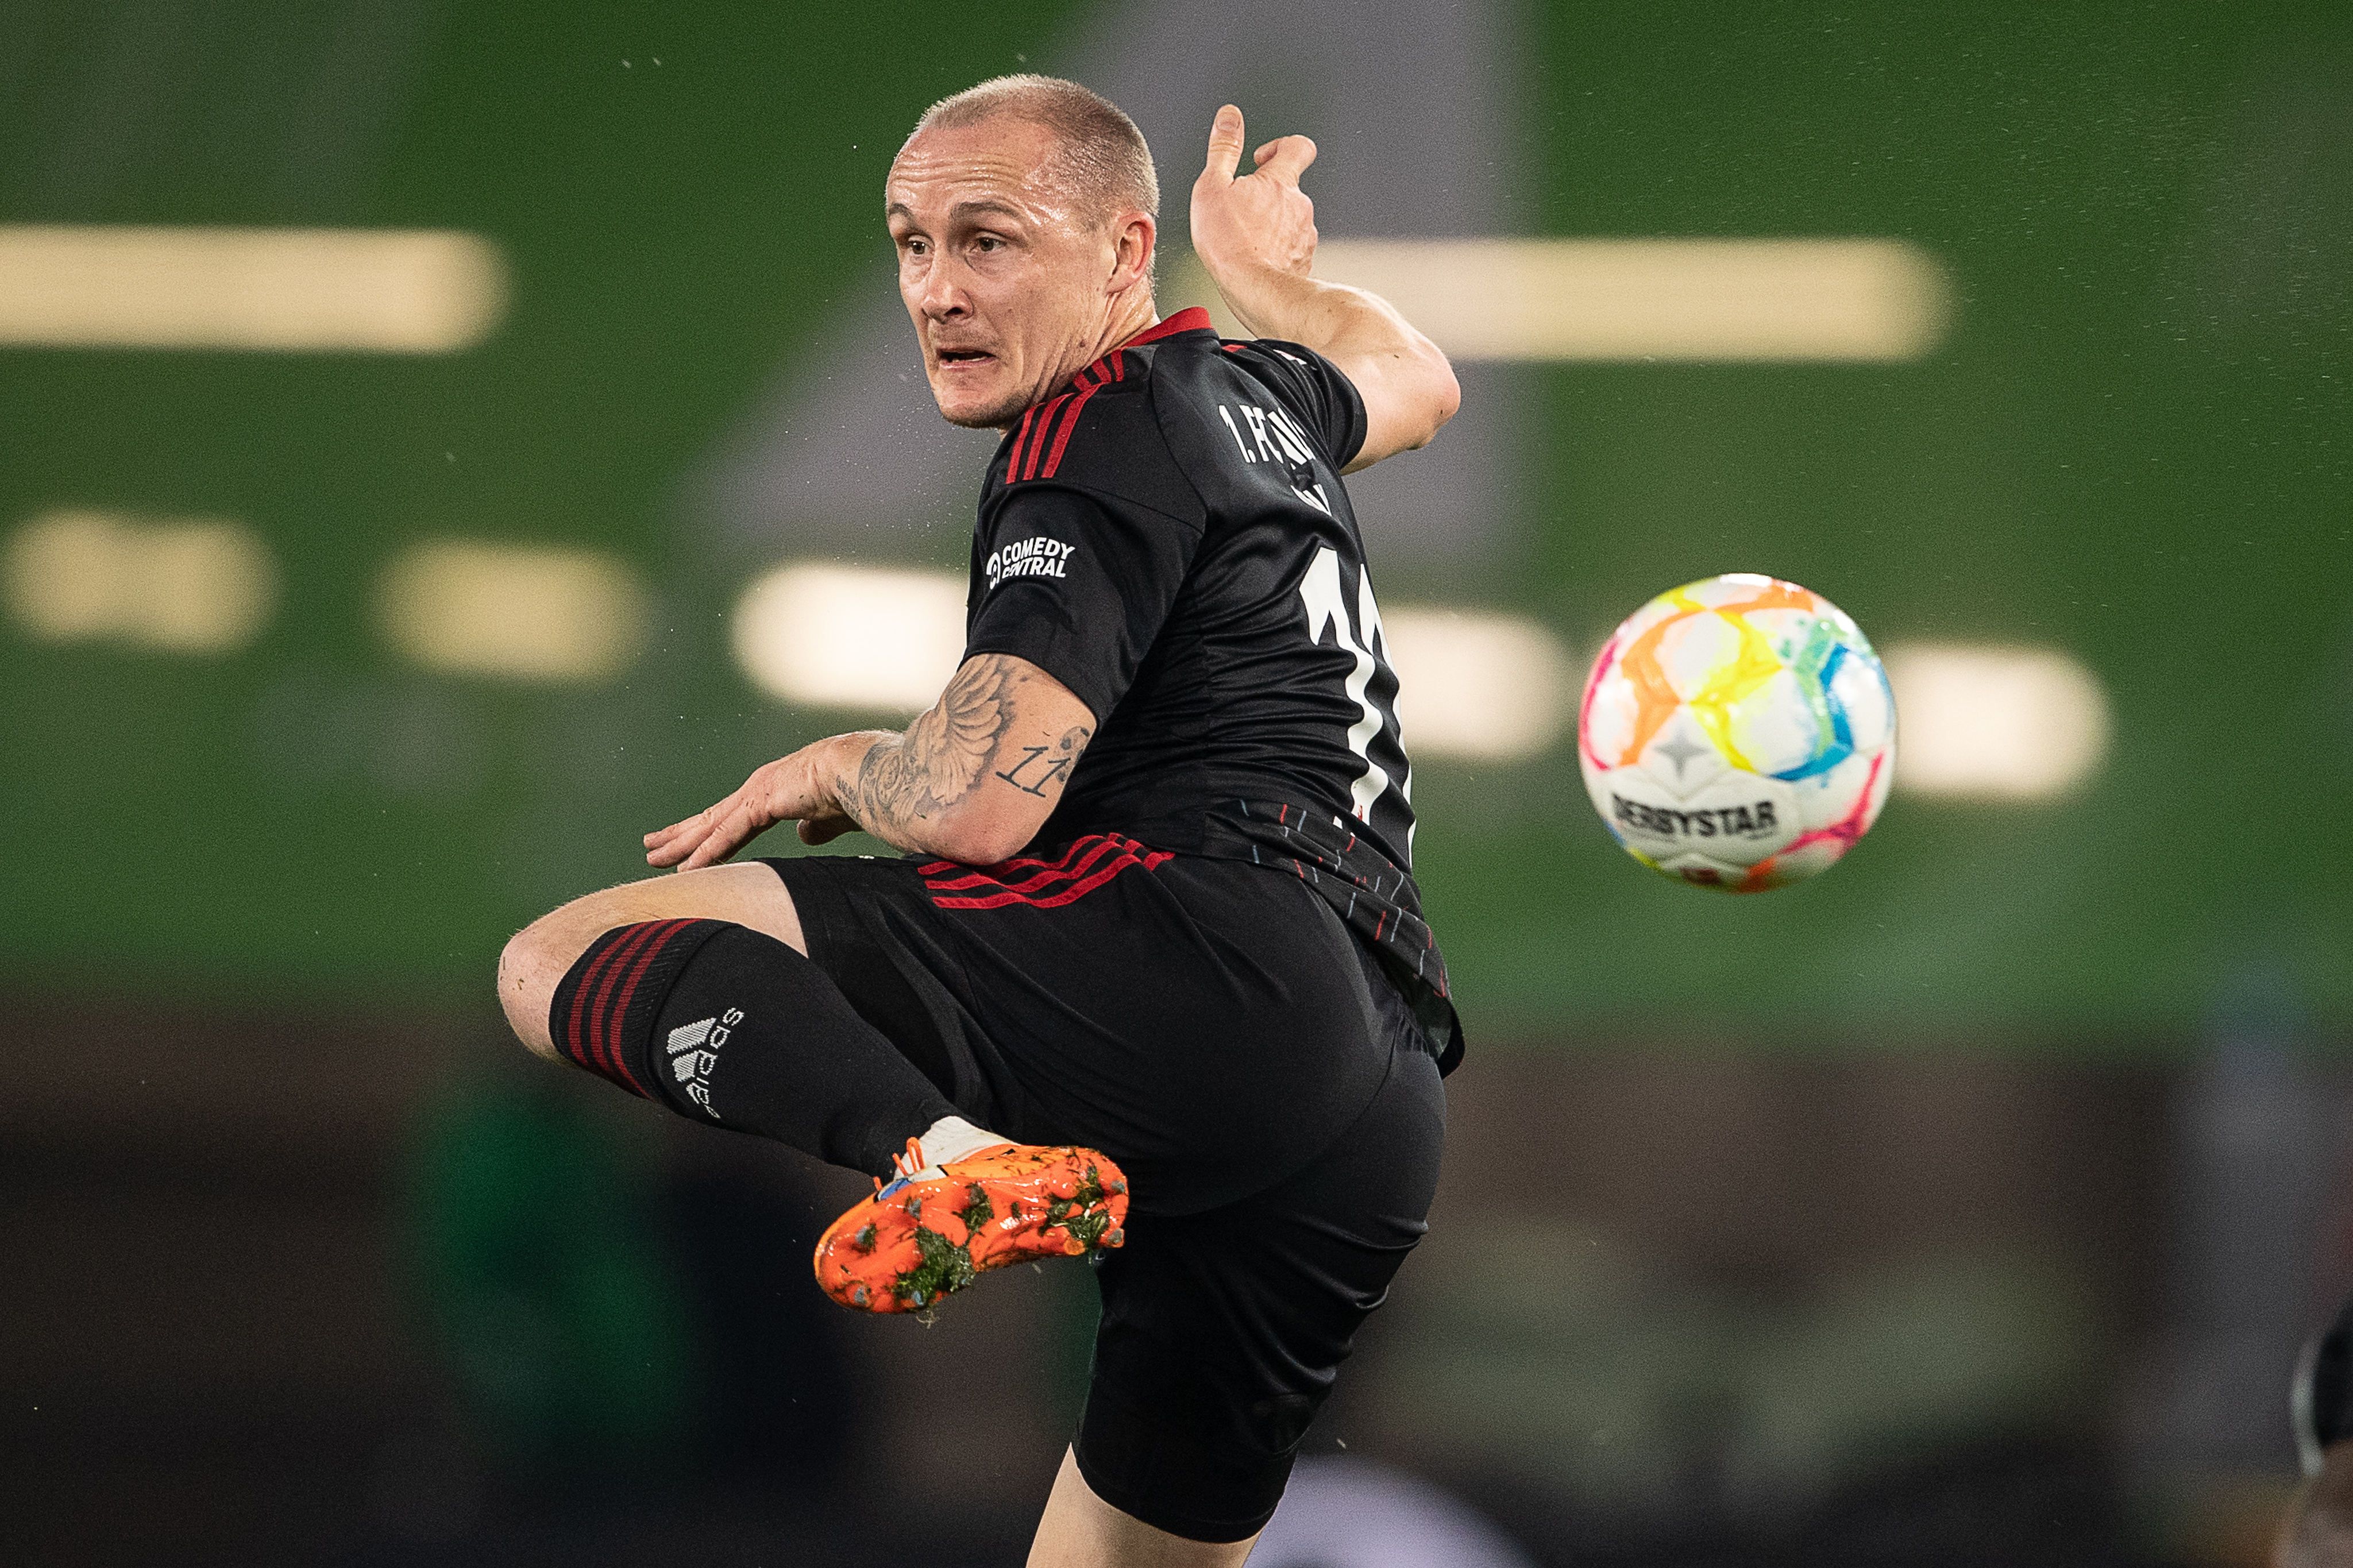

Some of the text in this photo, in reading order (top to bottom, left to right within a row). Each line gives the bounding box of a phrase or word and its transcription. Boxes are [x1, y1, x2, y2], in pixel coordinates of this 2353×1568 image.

[1002, 536, 1076, 566] COMEDY
[996, 746, 1071, 798] 11
[1613, 793, 1778, 837] DERBYSTAR
[692, 1007, 745, 1119] adidas
